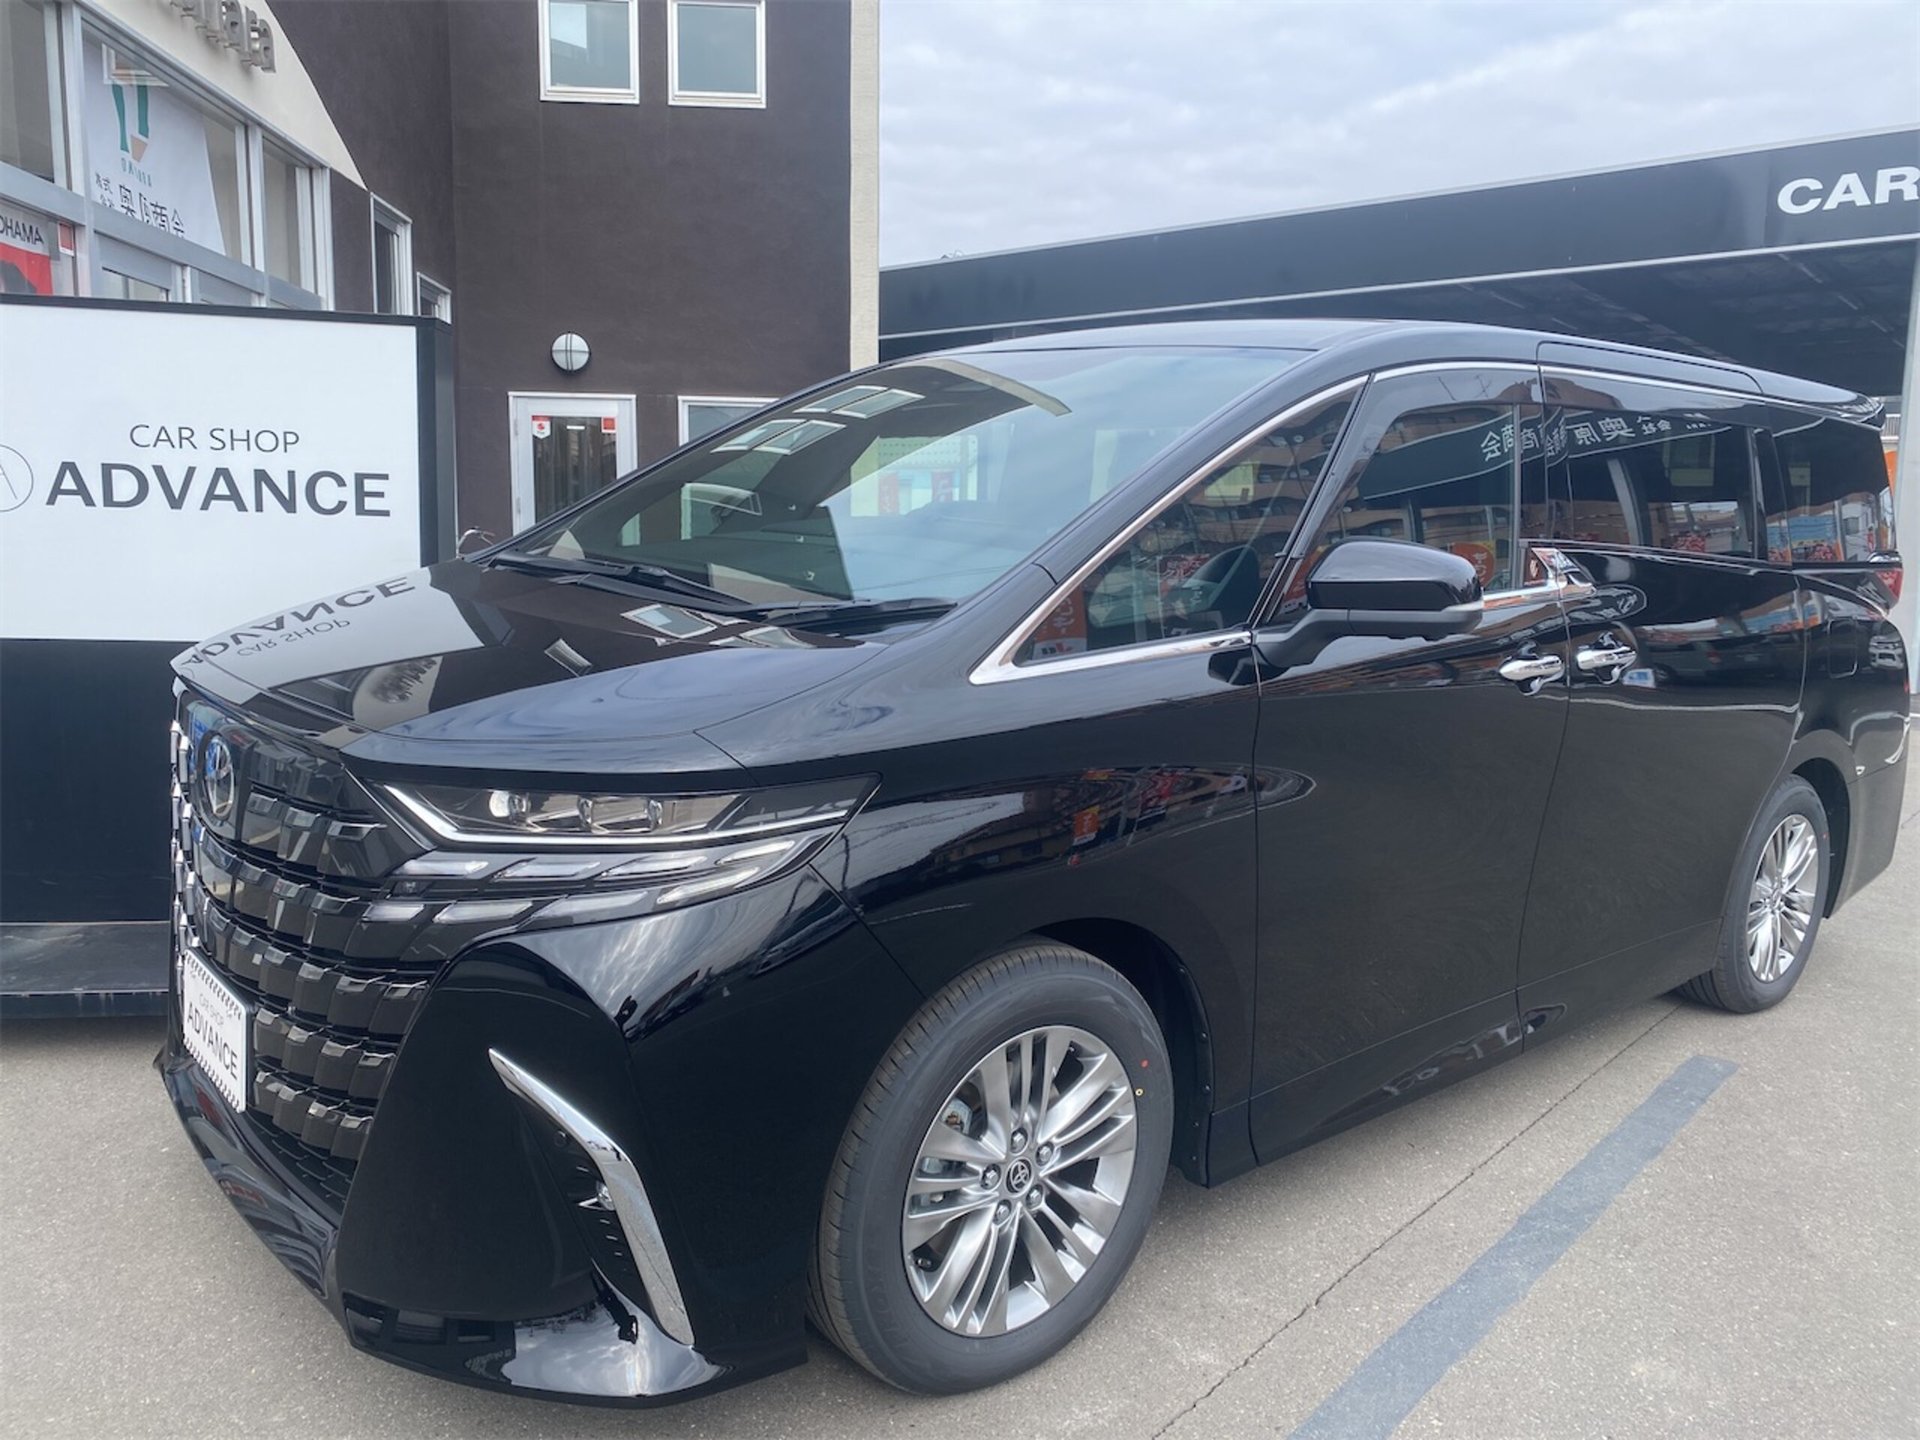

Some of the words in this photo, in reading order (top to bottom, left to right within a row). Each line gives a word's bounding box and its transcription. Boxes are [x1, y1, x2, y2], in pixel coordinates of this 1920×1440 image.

[1777, 166, 1920, 214] CAR
[129, 424, 198, 450] CAR
[209, 427, 300, 453] SHOP
[46, 461, 392, 518] ADVANCE
[187, 1002, 238, 1080] ADVANCE
